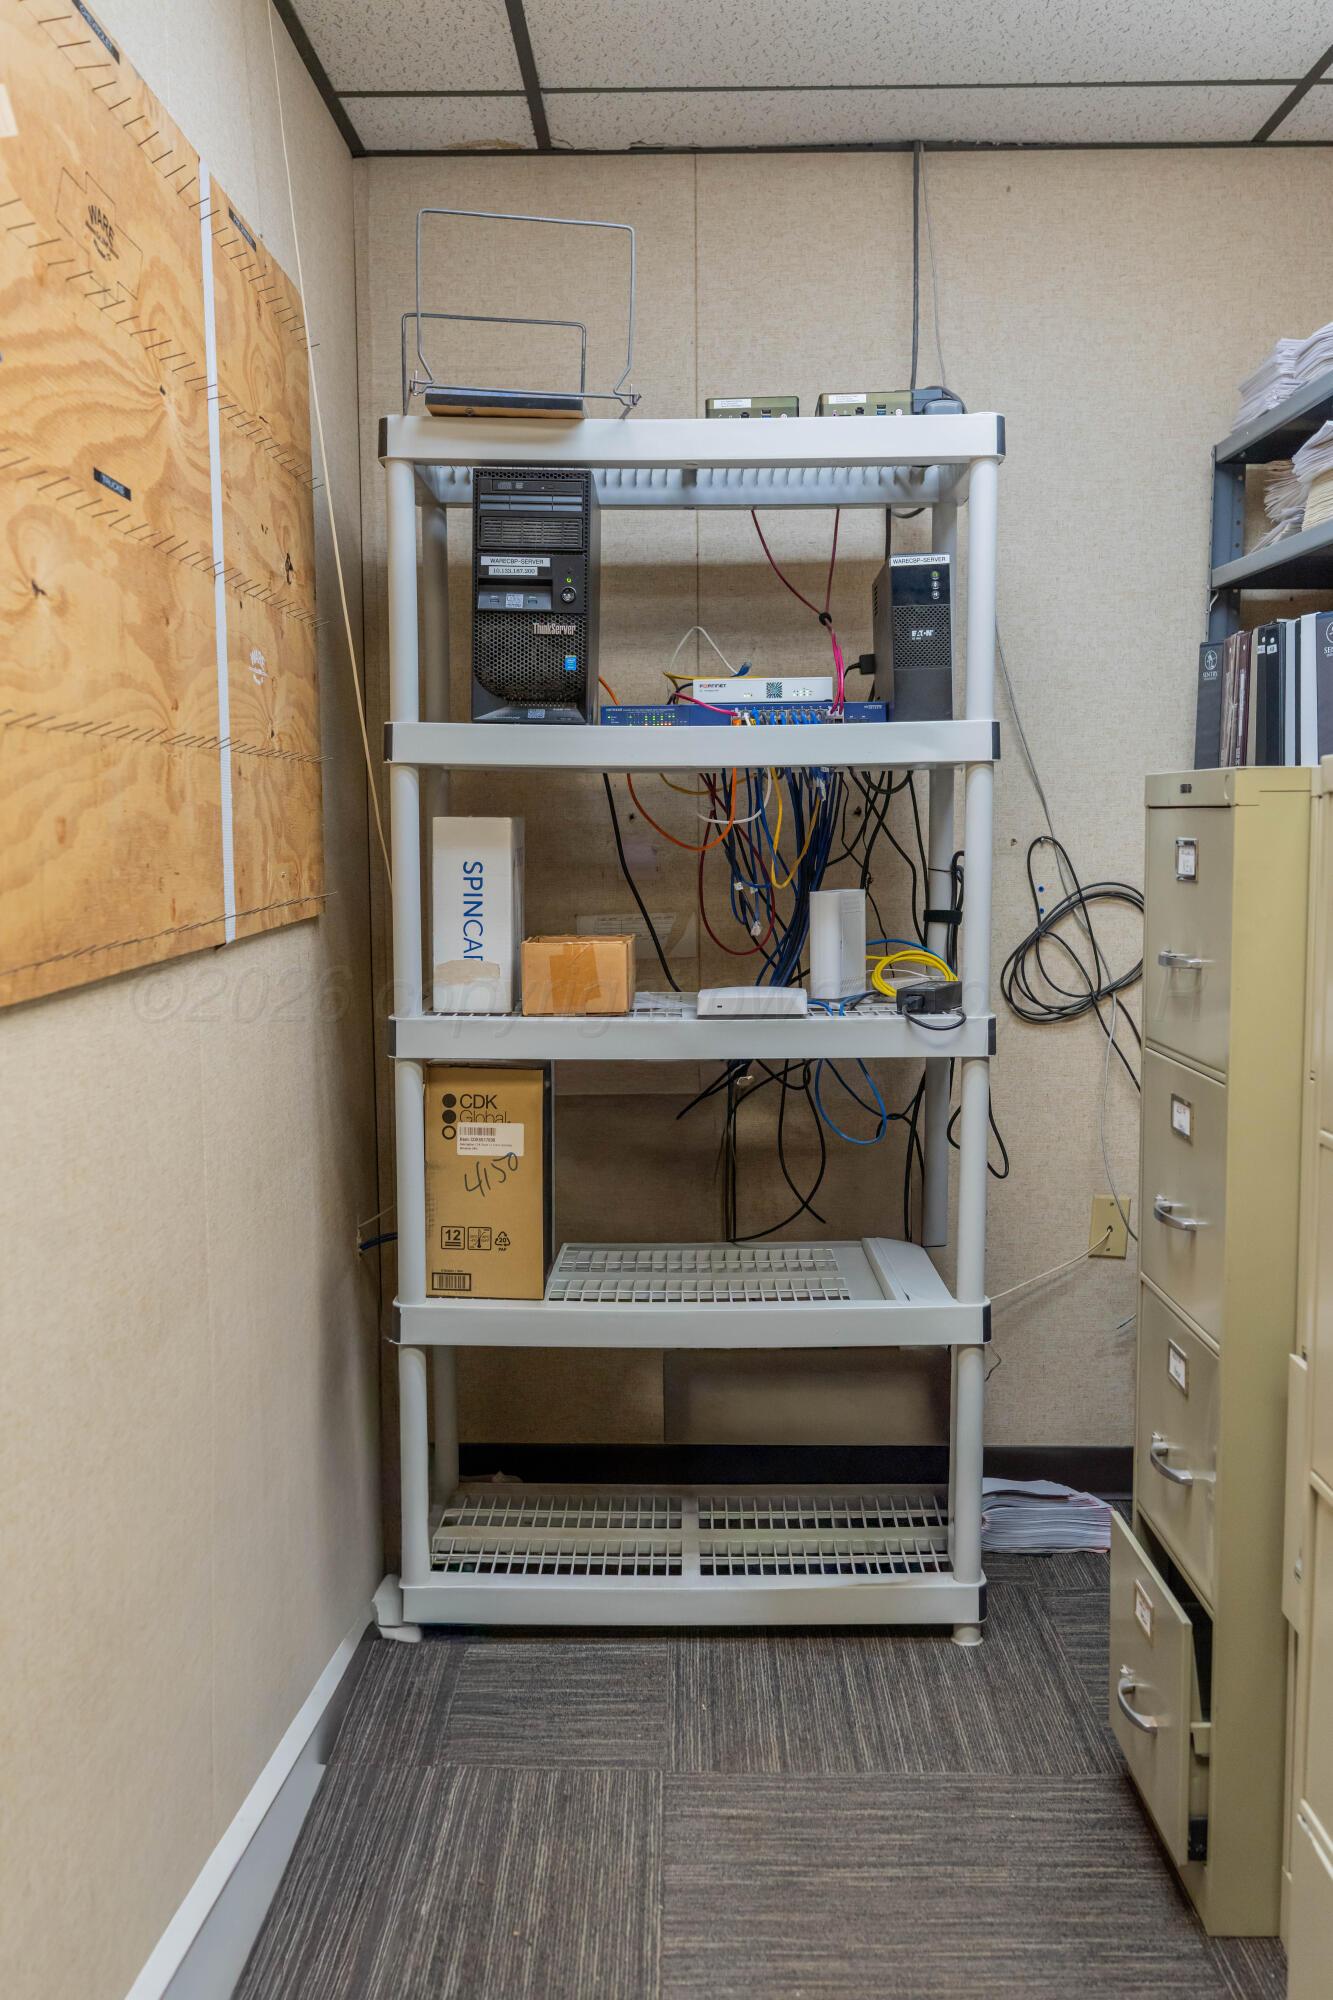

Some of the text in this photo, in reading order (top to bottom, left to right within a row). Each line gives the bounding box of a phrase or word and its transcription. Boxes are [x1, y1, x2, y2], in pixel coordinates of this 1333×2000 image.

[532, 622, 577, 636] ThinkServer
[460, 1093, 498, 1110] CDK
[464, 1151, 519, 1198] 4150
[445, 1229, 461, 1241] 12
